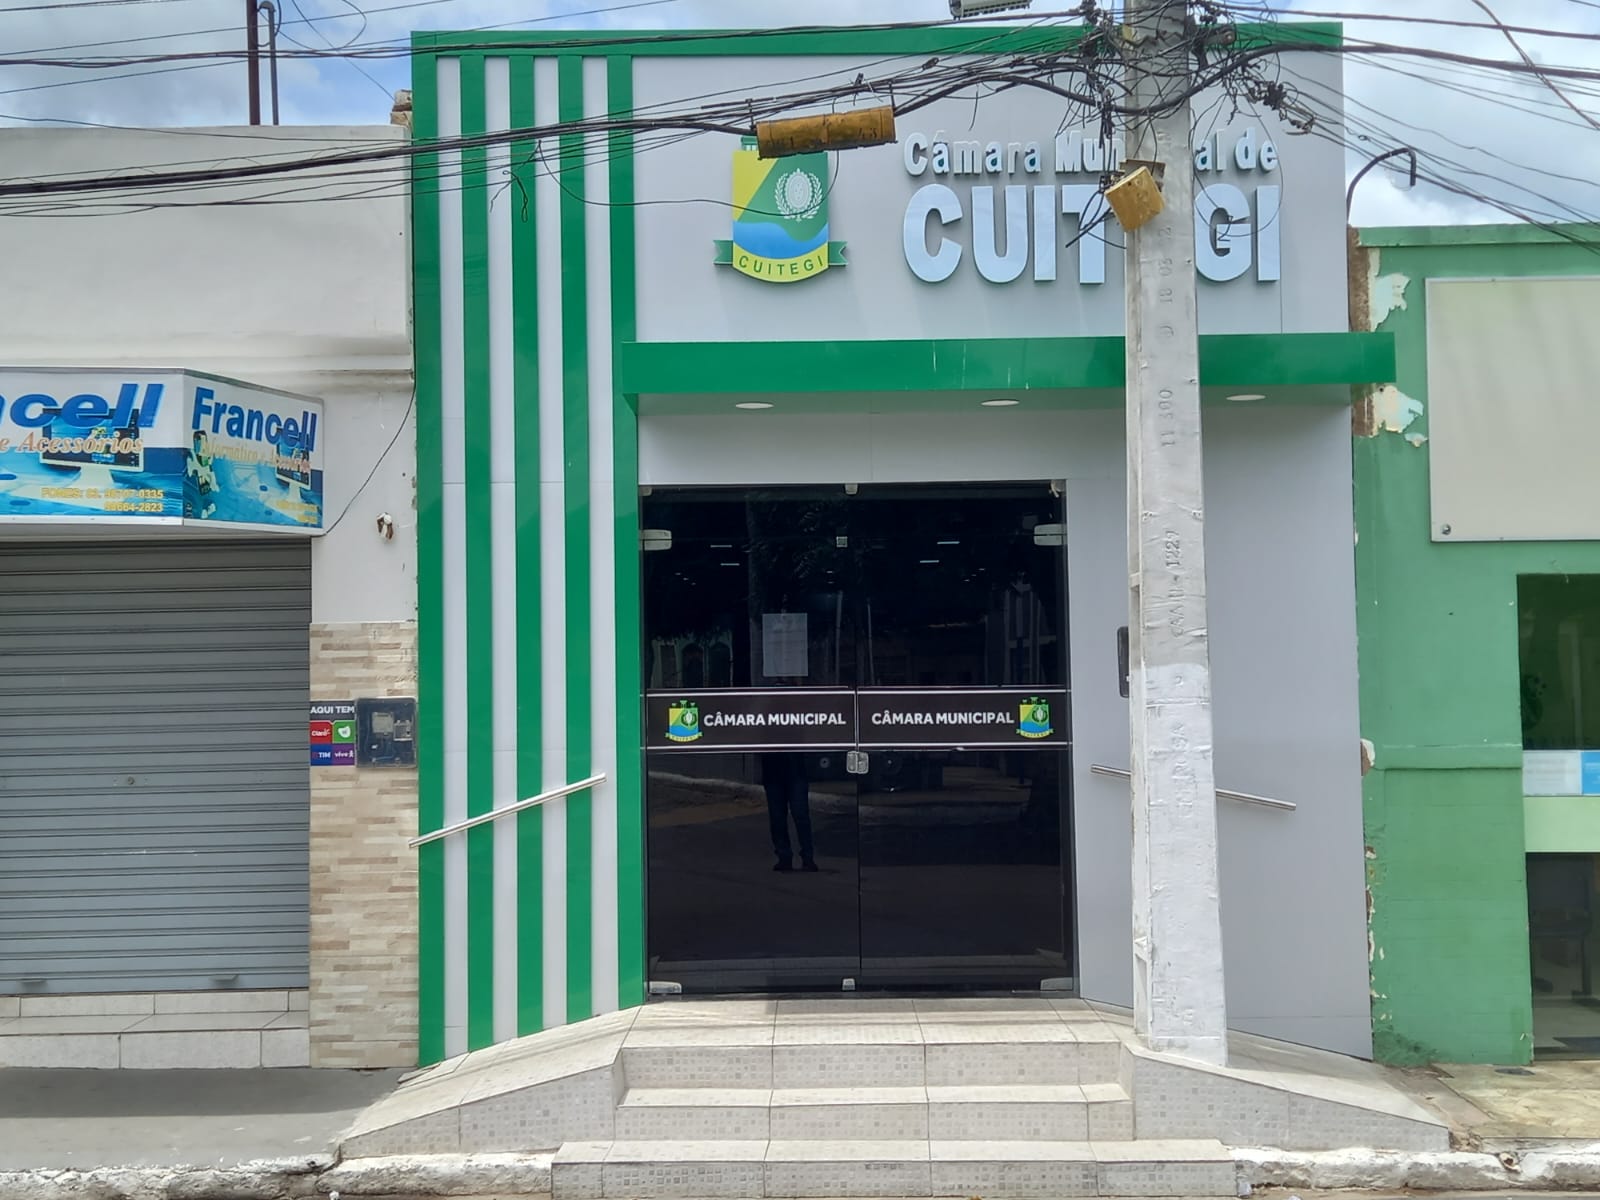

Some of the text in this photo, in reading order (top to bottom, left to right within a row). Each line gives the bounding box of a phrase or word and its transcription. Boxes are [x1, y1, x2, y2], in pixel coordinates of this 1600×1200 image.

[1055, 128, 1227, 174] Munal
[1235, 127, 1279, 172] de
[903, 183, 1281, 284] CUITGI
[739, 255, 823, 276] CUITEGI
[0, 383, 165, 428] cell
[191, 386, 318, 453] Francell
[16, 431, 144, 454] Acessórios
[310, 706, 355, 714] AQUI TEM
[703, 711, 846, 727] CÂMARA MUNICIPAL
[871, 710, 1015, 725] CÂMARA MUNICIPAL
